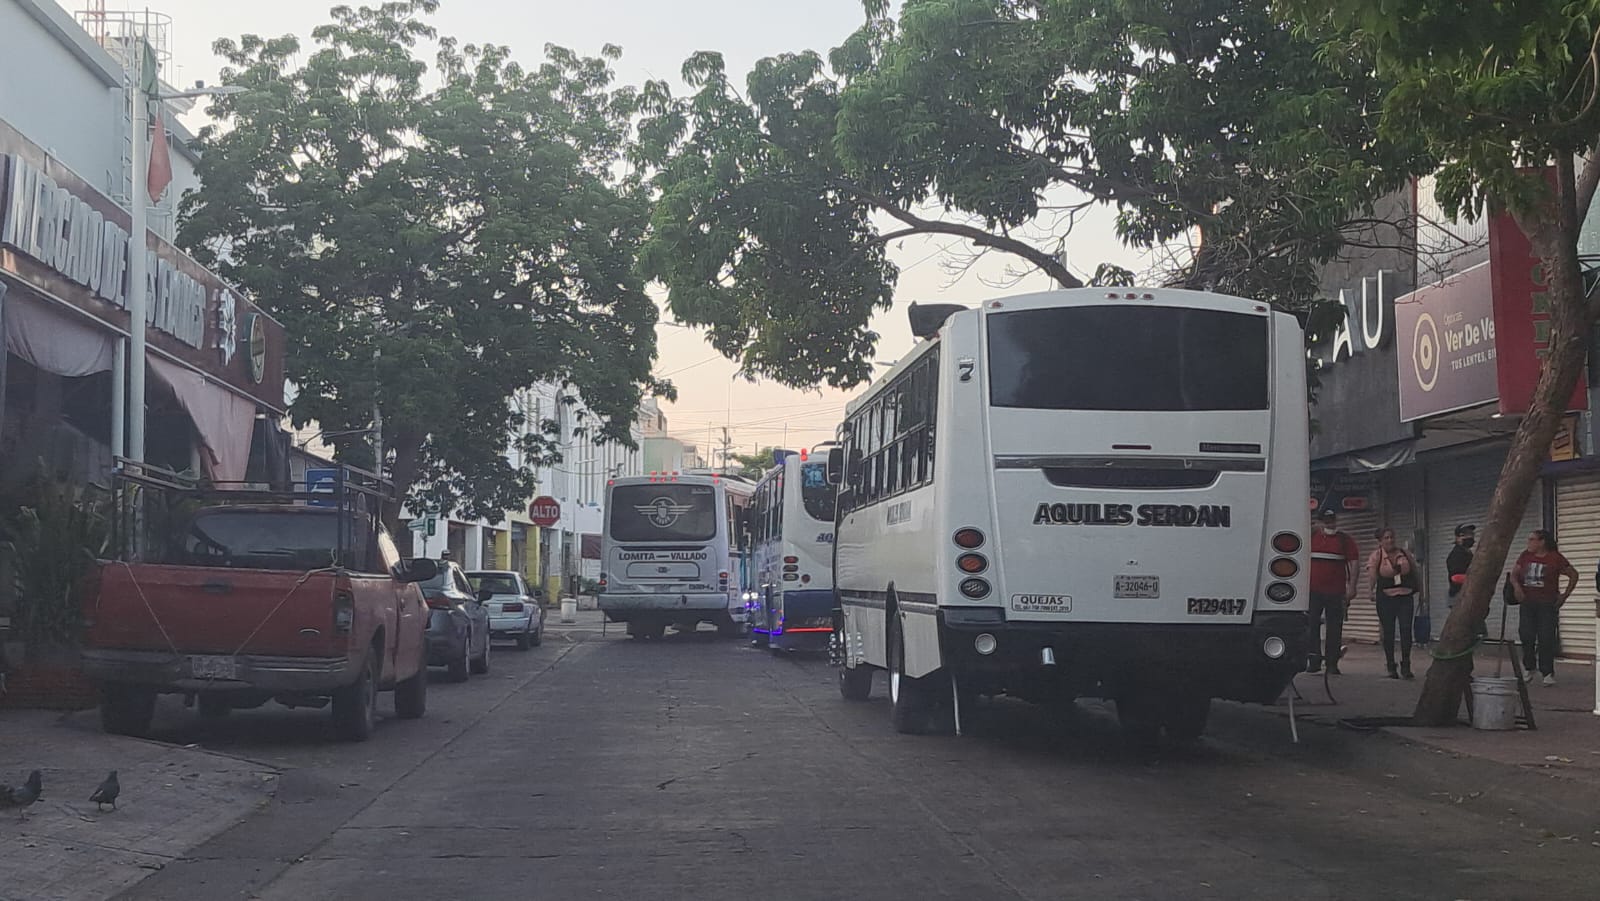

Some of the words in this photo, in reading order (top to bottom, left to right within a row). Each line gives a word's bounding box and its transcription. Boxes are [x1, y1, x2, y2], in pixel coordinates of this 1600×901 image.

[4, 153, 103, 292] MERCADO
[100, 220, 129, 308] DE
[1444, 329, 1464, 353] Ver
[1464, 323, 1480, 347] De
[958, 358, 976, 381] 7
[532, 504, 559, 519] ALTO
[1033, 502, 1133, 526] AQUILES
[1136, 504, 1231, 528] SERDAN
[618, 552, 656, 561] LOMITA
[670, 552, 708, 560] VALLADO
[1020, 595, 1063, 605] QUEJAS
